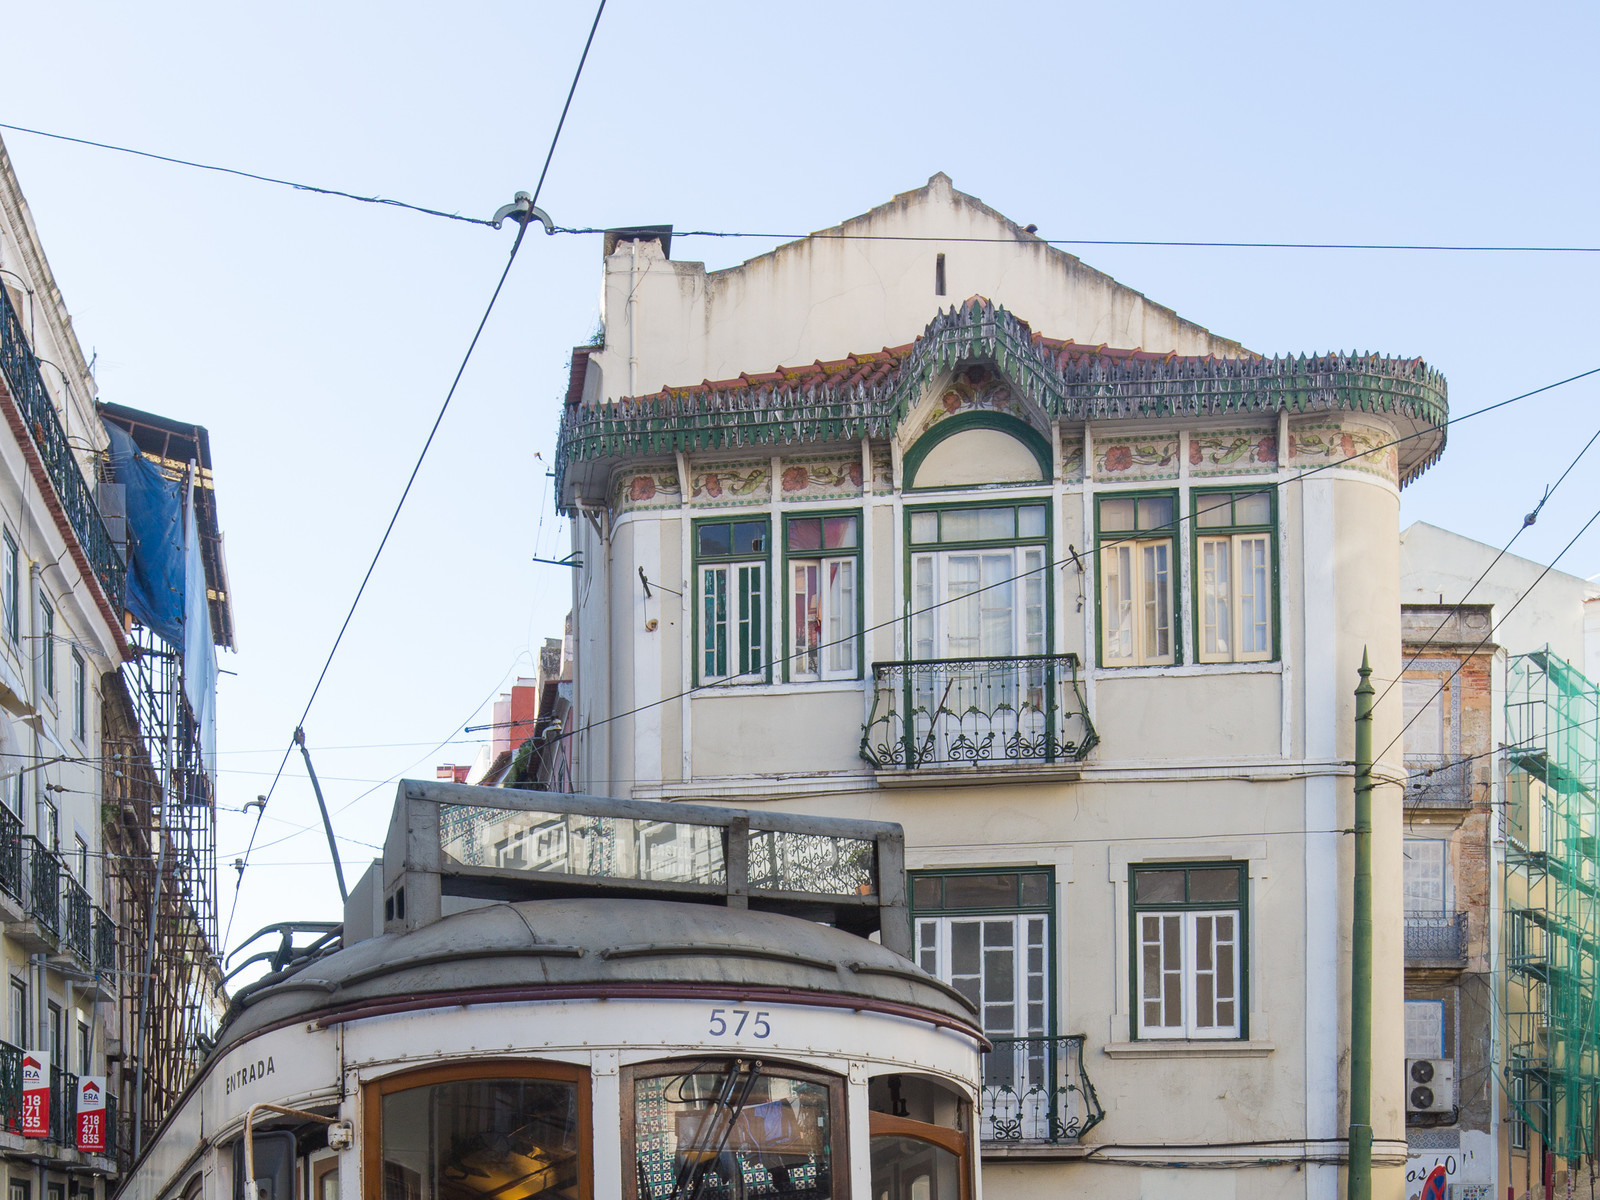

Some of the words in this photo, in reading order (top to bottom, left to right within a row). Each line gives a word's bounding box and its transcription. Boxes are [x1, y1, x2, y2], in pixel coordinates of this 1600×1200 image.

[708, 1008, 771, 1039] 575
[23, 1070, 40, 1079] RA
[226, 1056, 275, 1095] ENTRADA
[83, 1093, 99, 1101] ERA
[82, 1115, 100, 1125] 218
[82, 1124, 99, 1134] 471
[82, 1134, 99, 1144] 835
